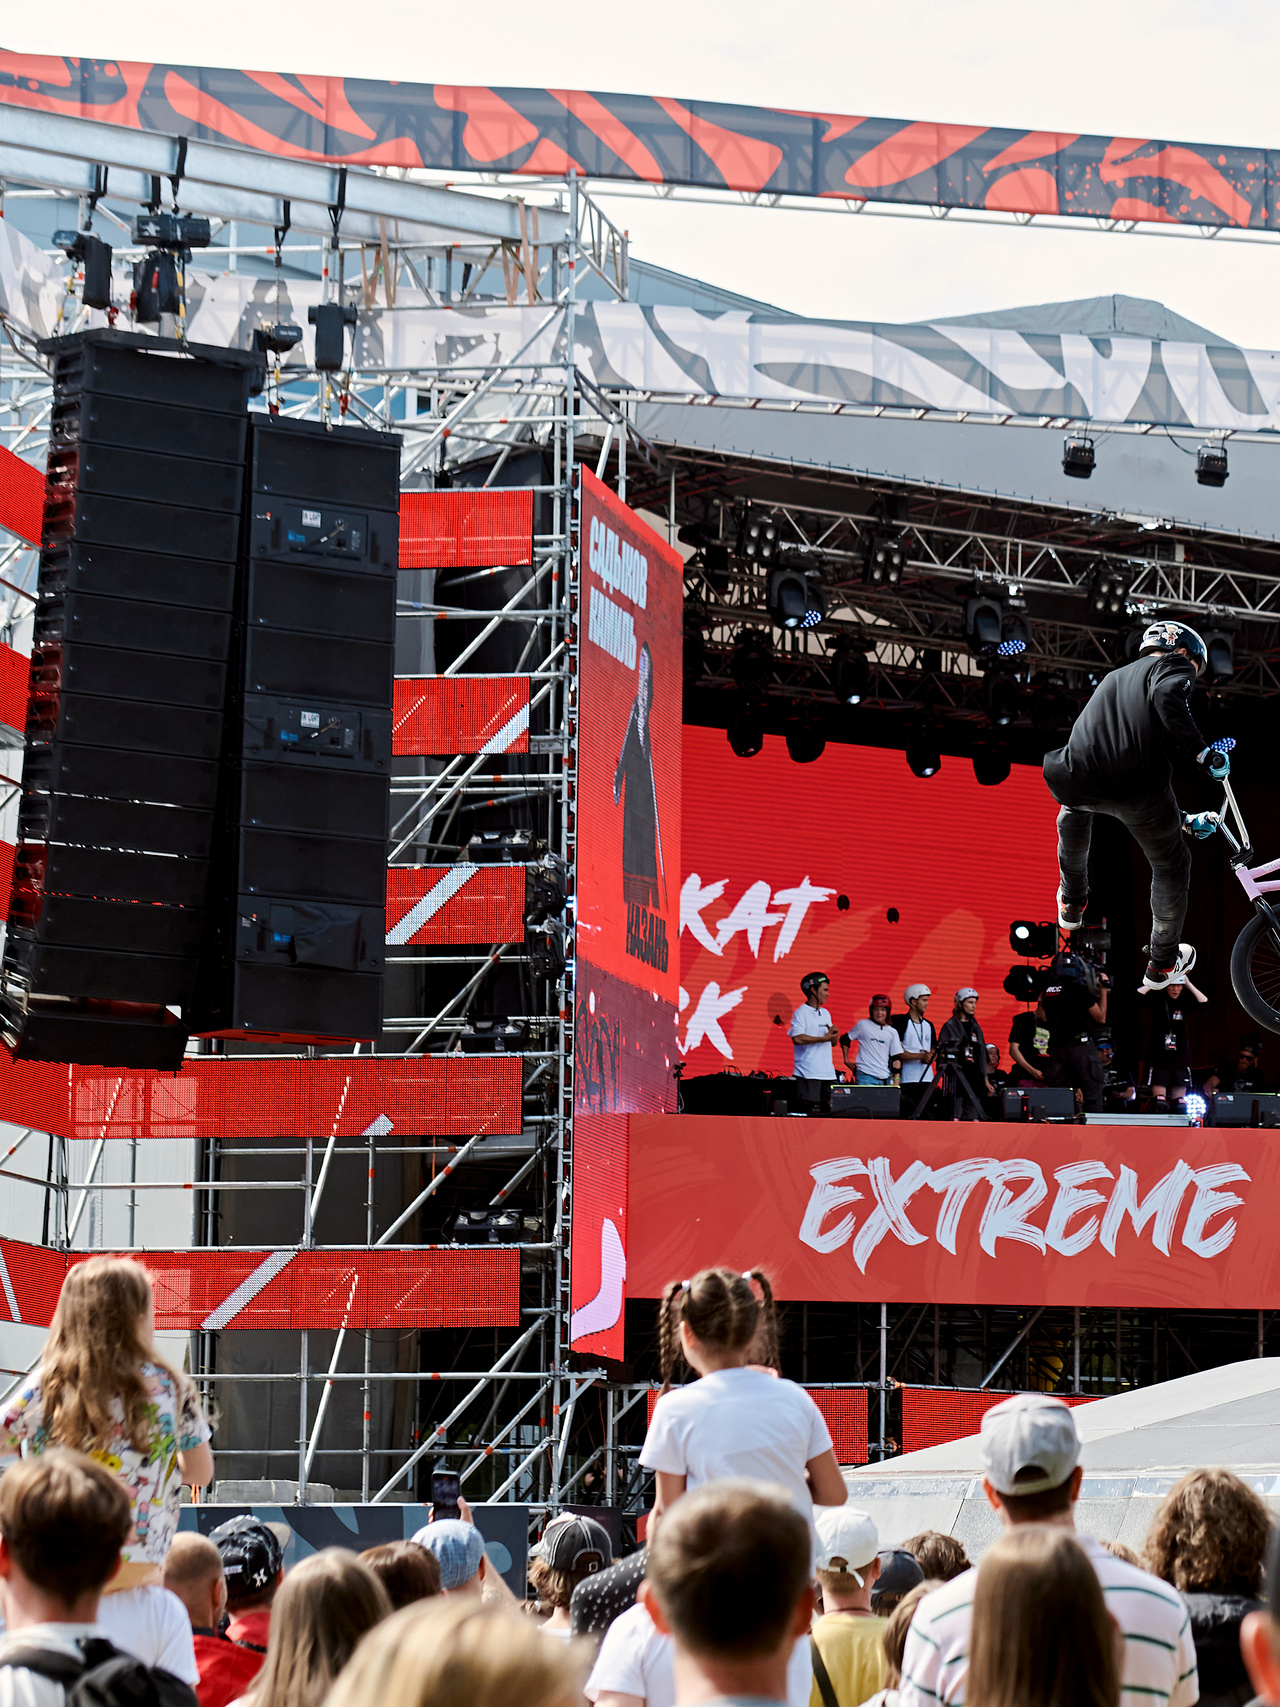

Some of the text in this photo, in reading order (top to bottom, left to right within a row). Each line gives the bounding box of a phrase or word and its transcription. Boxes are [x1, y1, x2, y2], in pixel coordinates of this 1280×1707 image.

[588, 515, 648, 610] САДЫКОВ
[588, 585, 638, 671] КАМИЛЬ
[626, 901, 669, 974] КАЗАНЬ
[798, 1155, 1253, 1276] EXTREME
